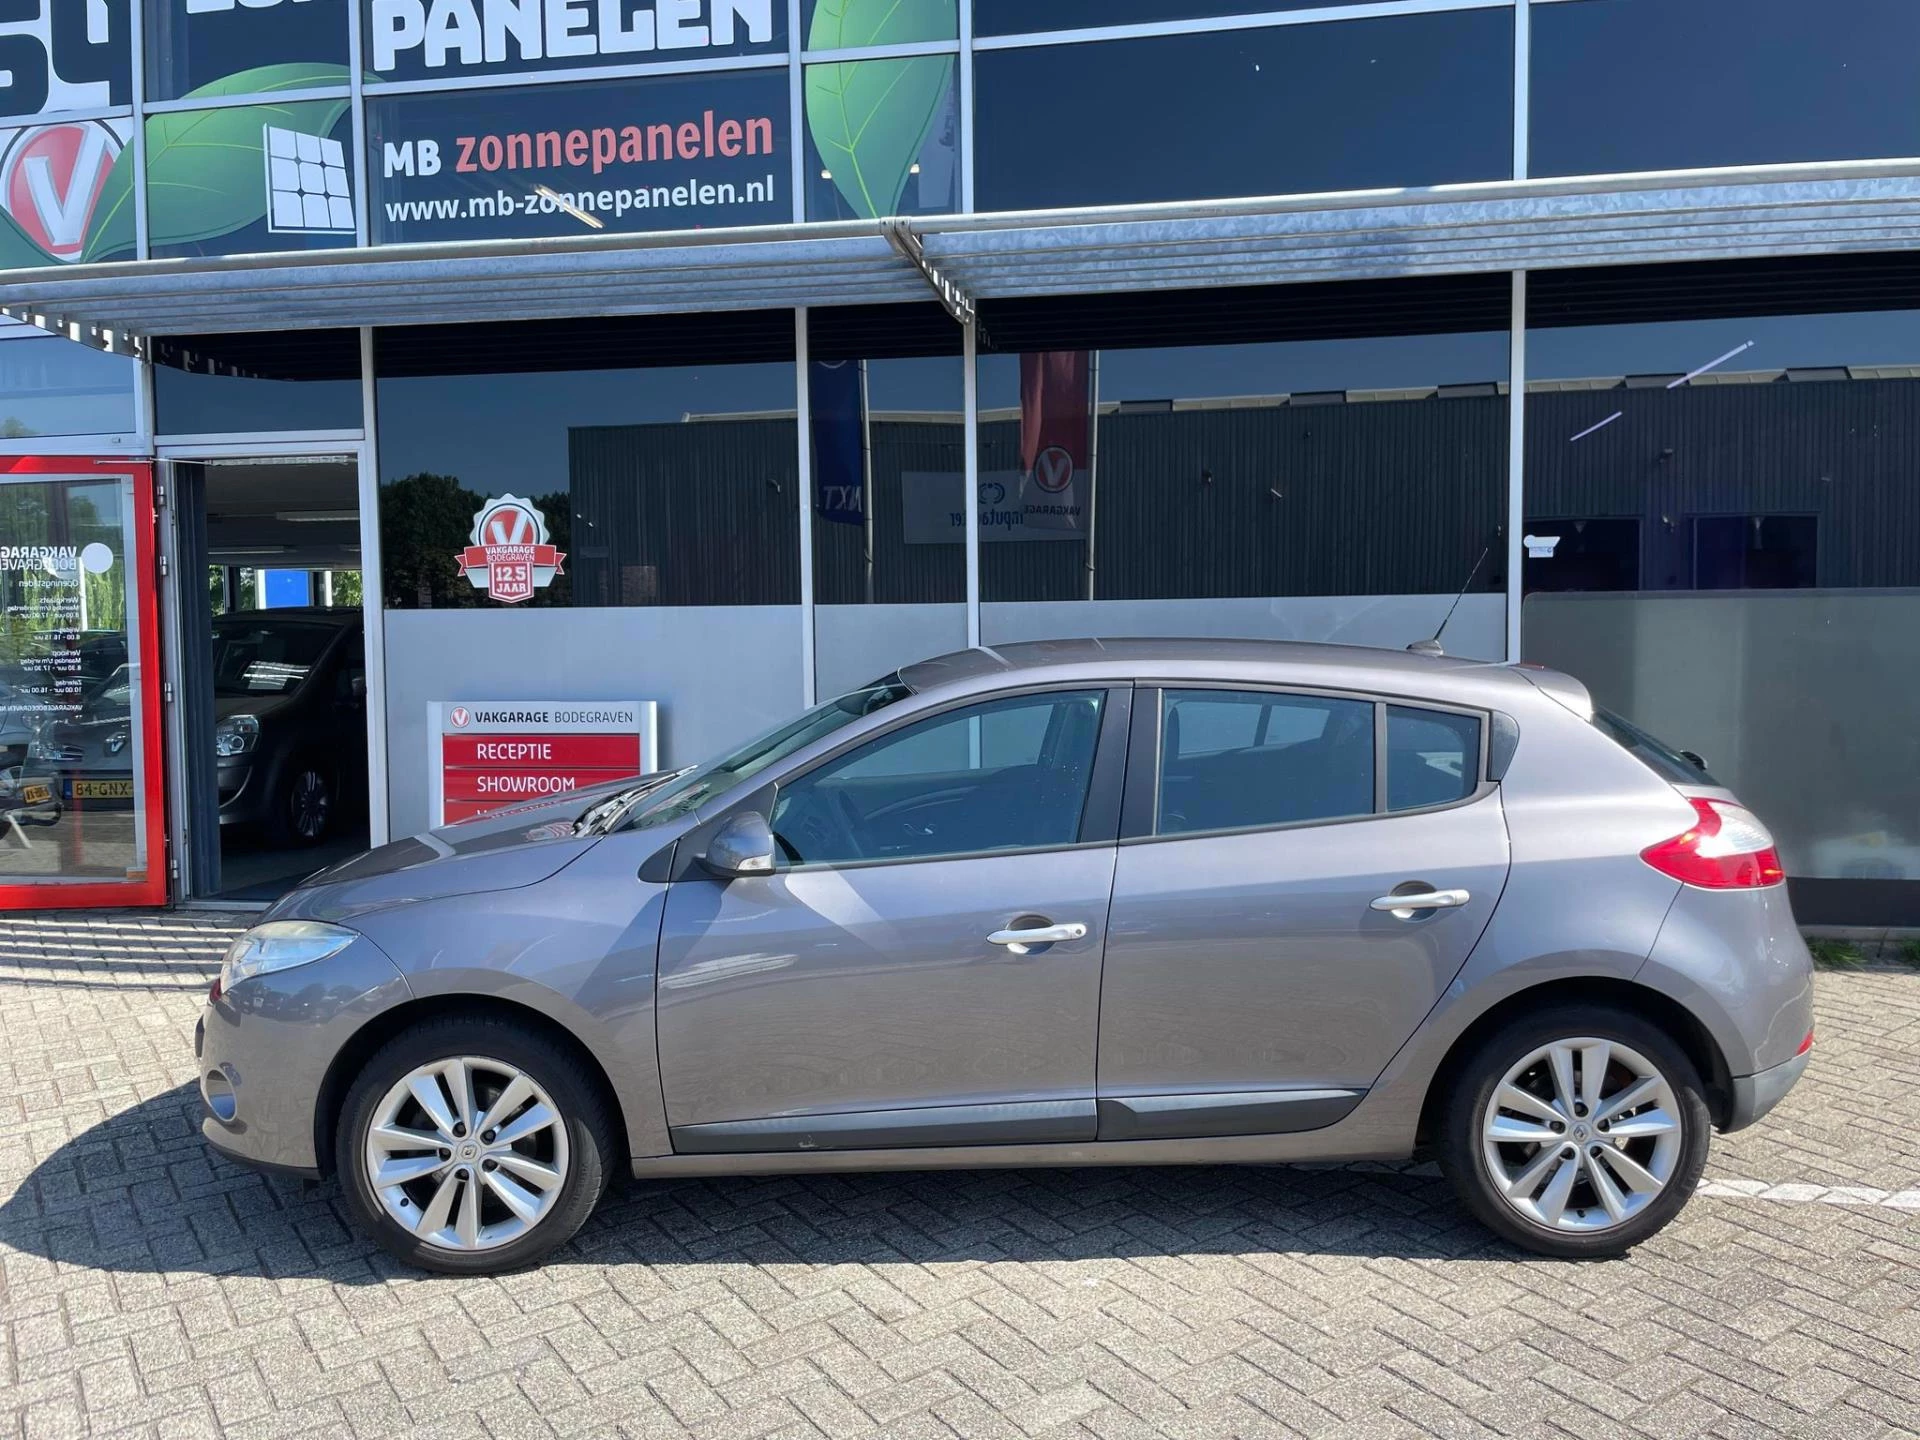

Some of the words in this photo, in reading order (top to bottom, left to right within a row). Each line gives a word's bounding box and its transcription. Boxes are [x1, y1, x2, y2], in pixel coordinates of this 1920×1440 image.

[371, 0, 773, 72] PANELEN
[384, 139, 442, 178] MB
[455, 109, 773, 175] zonnepanelen
[385, 174, 774, 223] www.mb-zonnepanelen.nl
[485, 546, 535, 554] VAKGARAGE
[486, 553, 535, 562] BODEGRAVEN
[495, 566, 527, 582] 12.5
[496, 583, 527, 593] JAAR
[475, 711, 549, 723] VAKGARAGE
[554, 711, 633, 723] BODEGRAVEN
[476, 743, 552, 760] RECEPTIE
[476, 776, 576, 793] SHOWROOM
